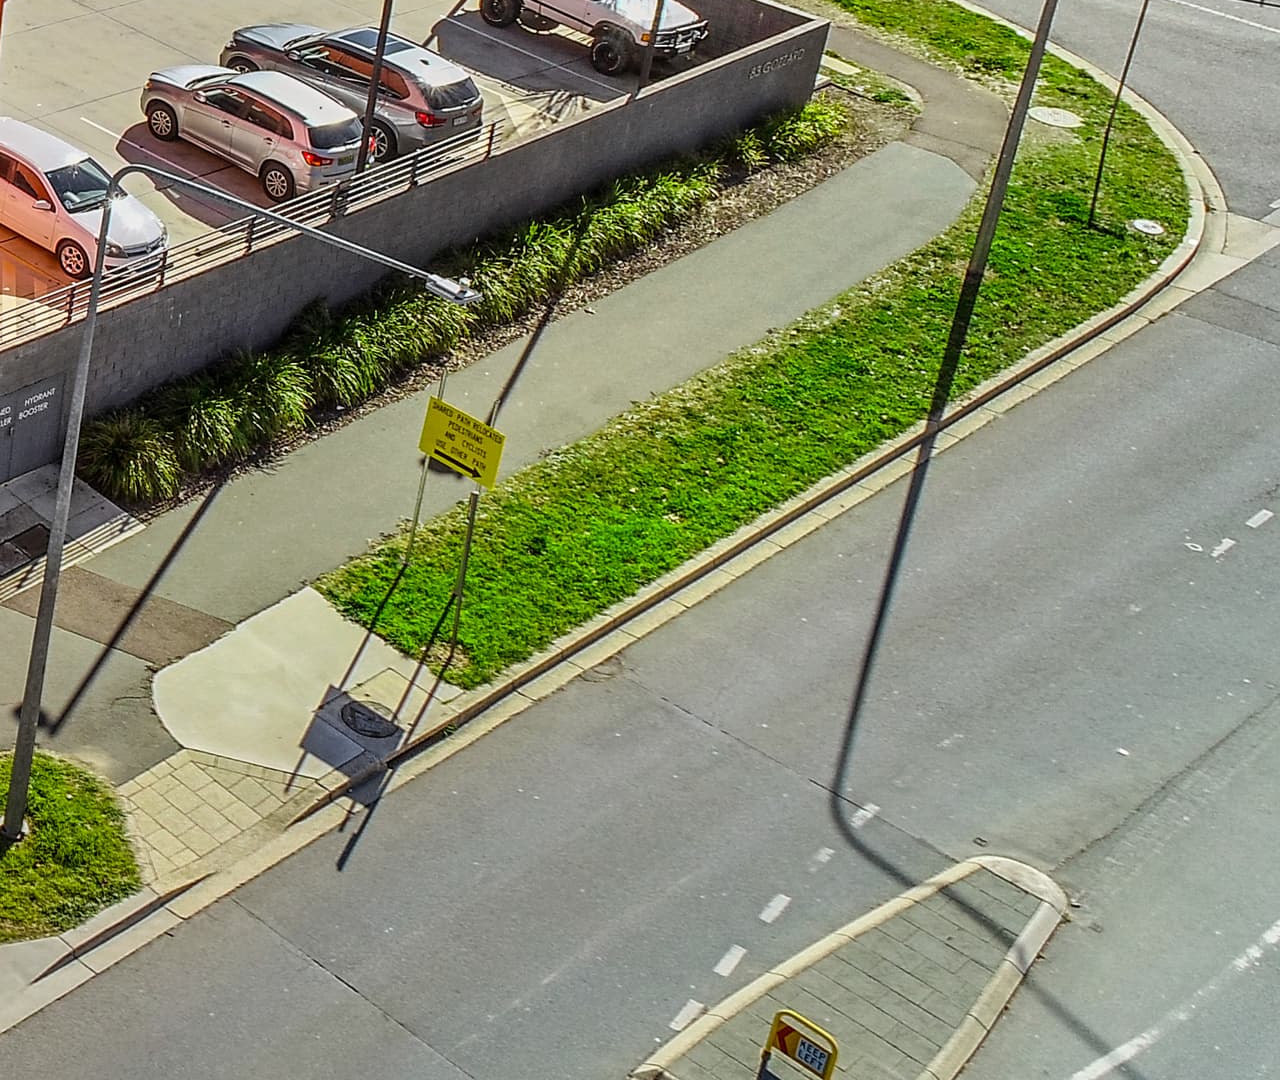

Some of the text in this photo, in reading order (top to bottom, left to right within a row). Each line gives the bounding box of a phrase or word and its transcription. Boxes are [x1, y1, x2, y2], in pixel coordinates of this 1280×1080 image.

[24, 387, 56, 407] HYDRANT
[18, 401, 49, 420] BOOSTER
[432, 401, 503, 445] SHARED PATH RELOCATED
[448, 420, 483, 445] PEDESTRIANS
[444, 430, 456, 442] AND
[435, 439, 487, 471] USE OTHER PATH
[797, 1049, 823, 1071] LEFT
[800, 1039, 826, 1061] KEEP
